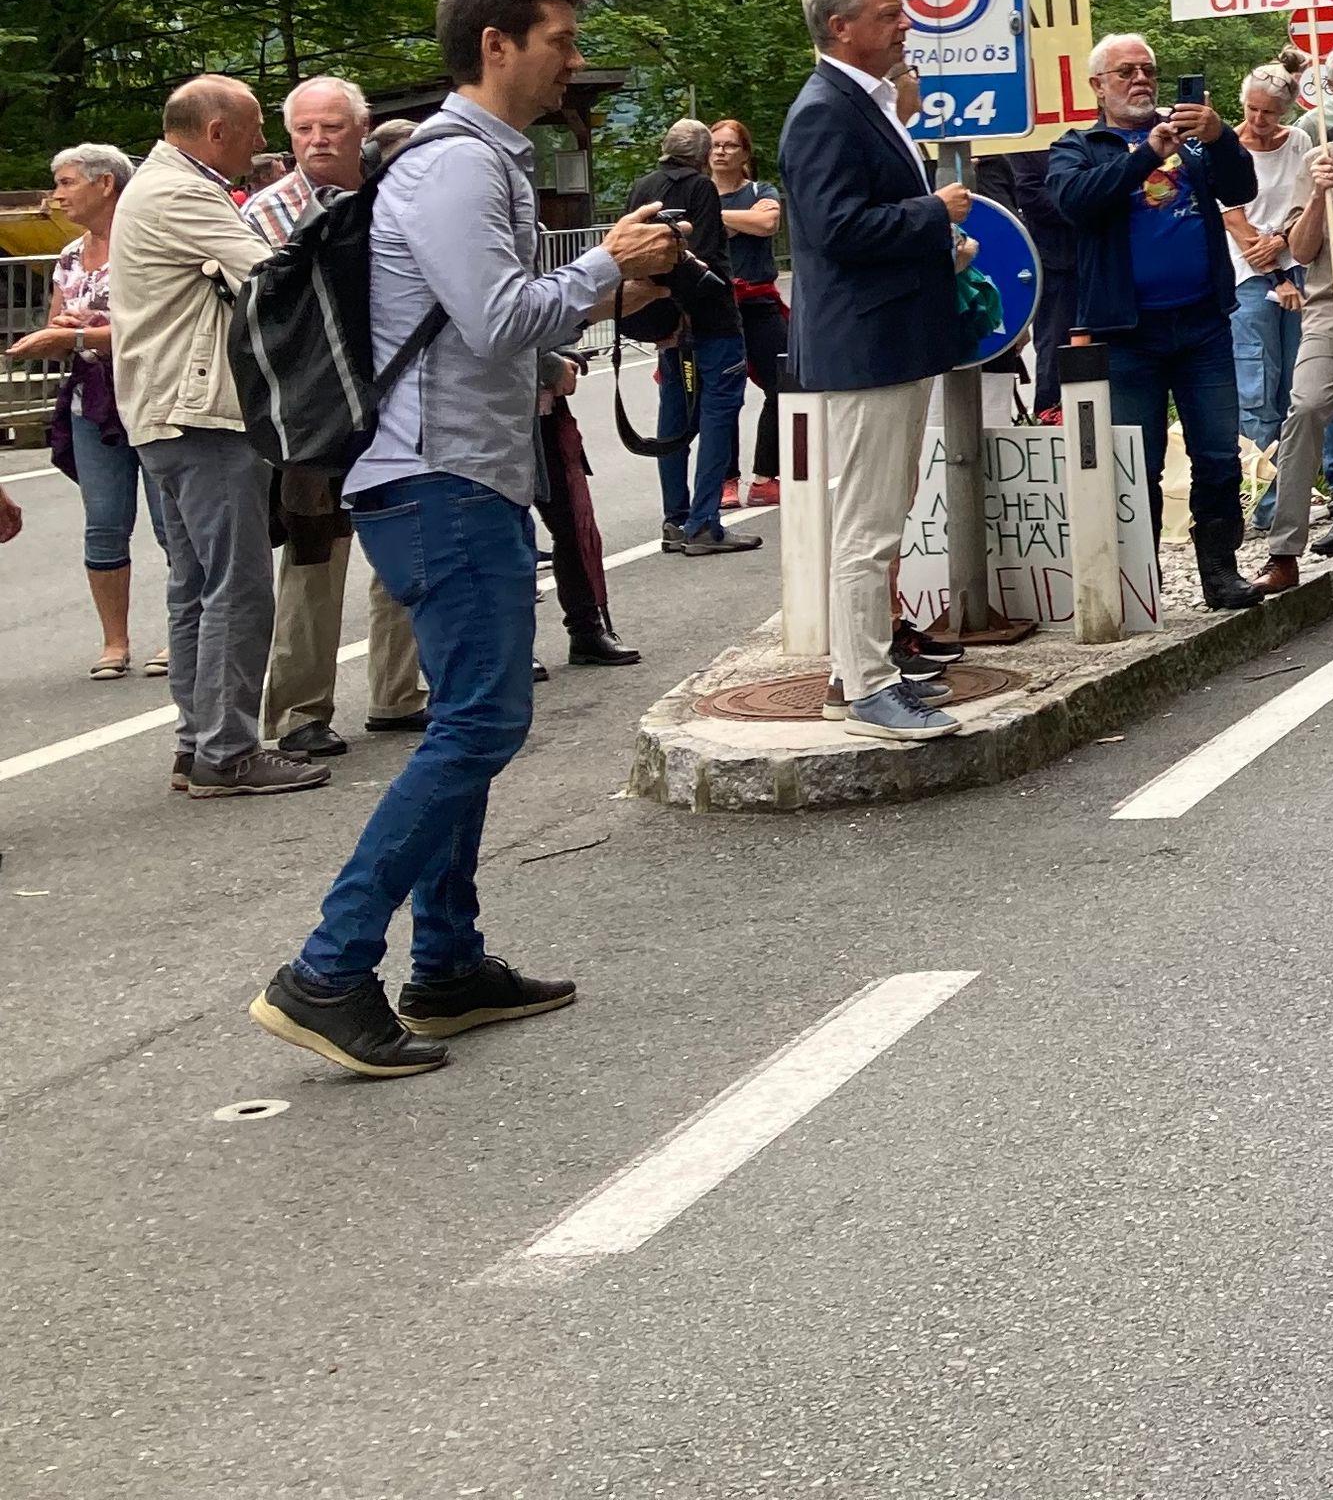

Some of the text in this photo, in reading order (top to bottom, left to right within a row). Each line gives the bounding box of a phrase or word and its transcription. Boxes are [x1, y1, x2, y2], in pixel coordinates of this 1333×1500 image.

[983, 44, 1010, 61] Ö3
[906, 91, 996, 128] 9.4
[683, 360, 693, 392] Nikon
